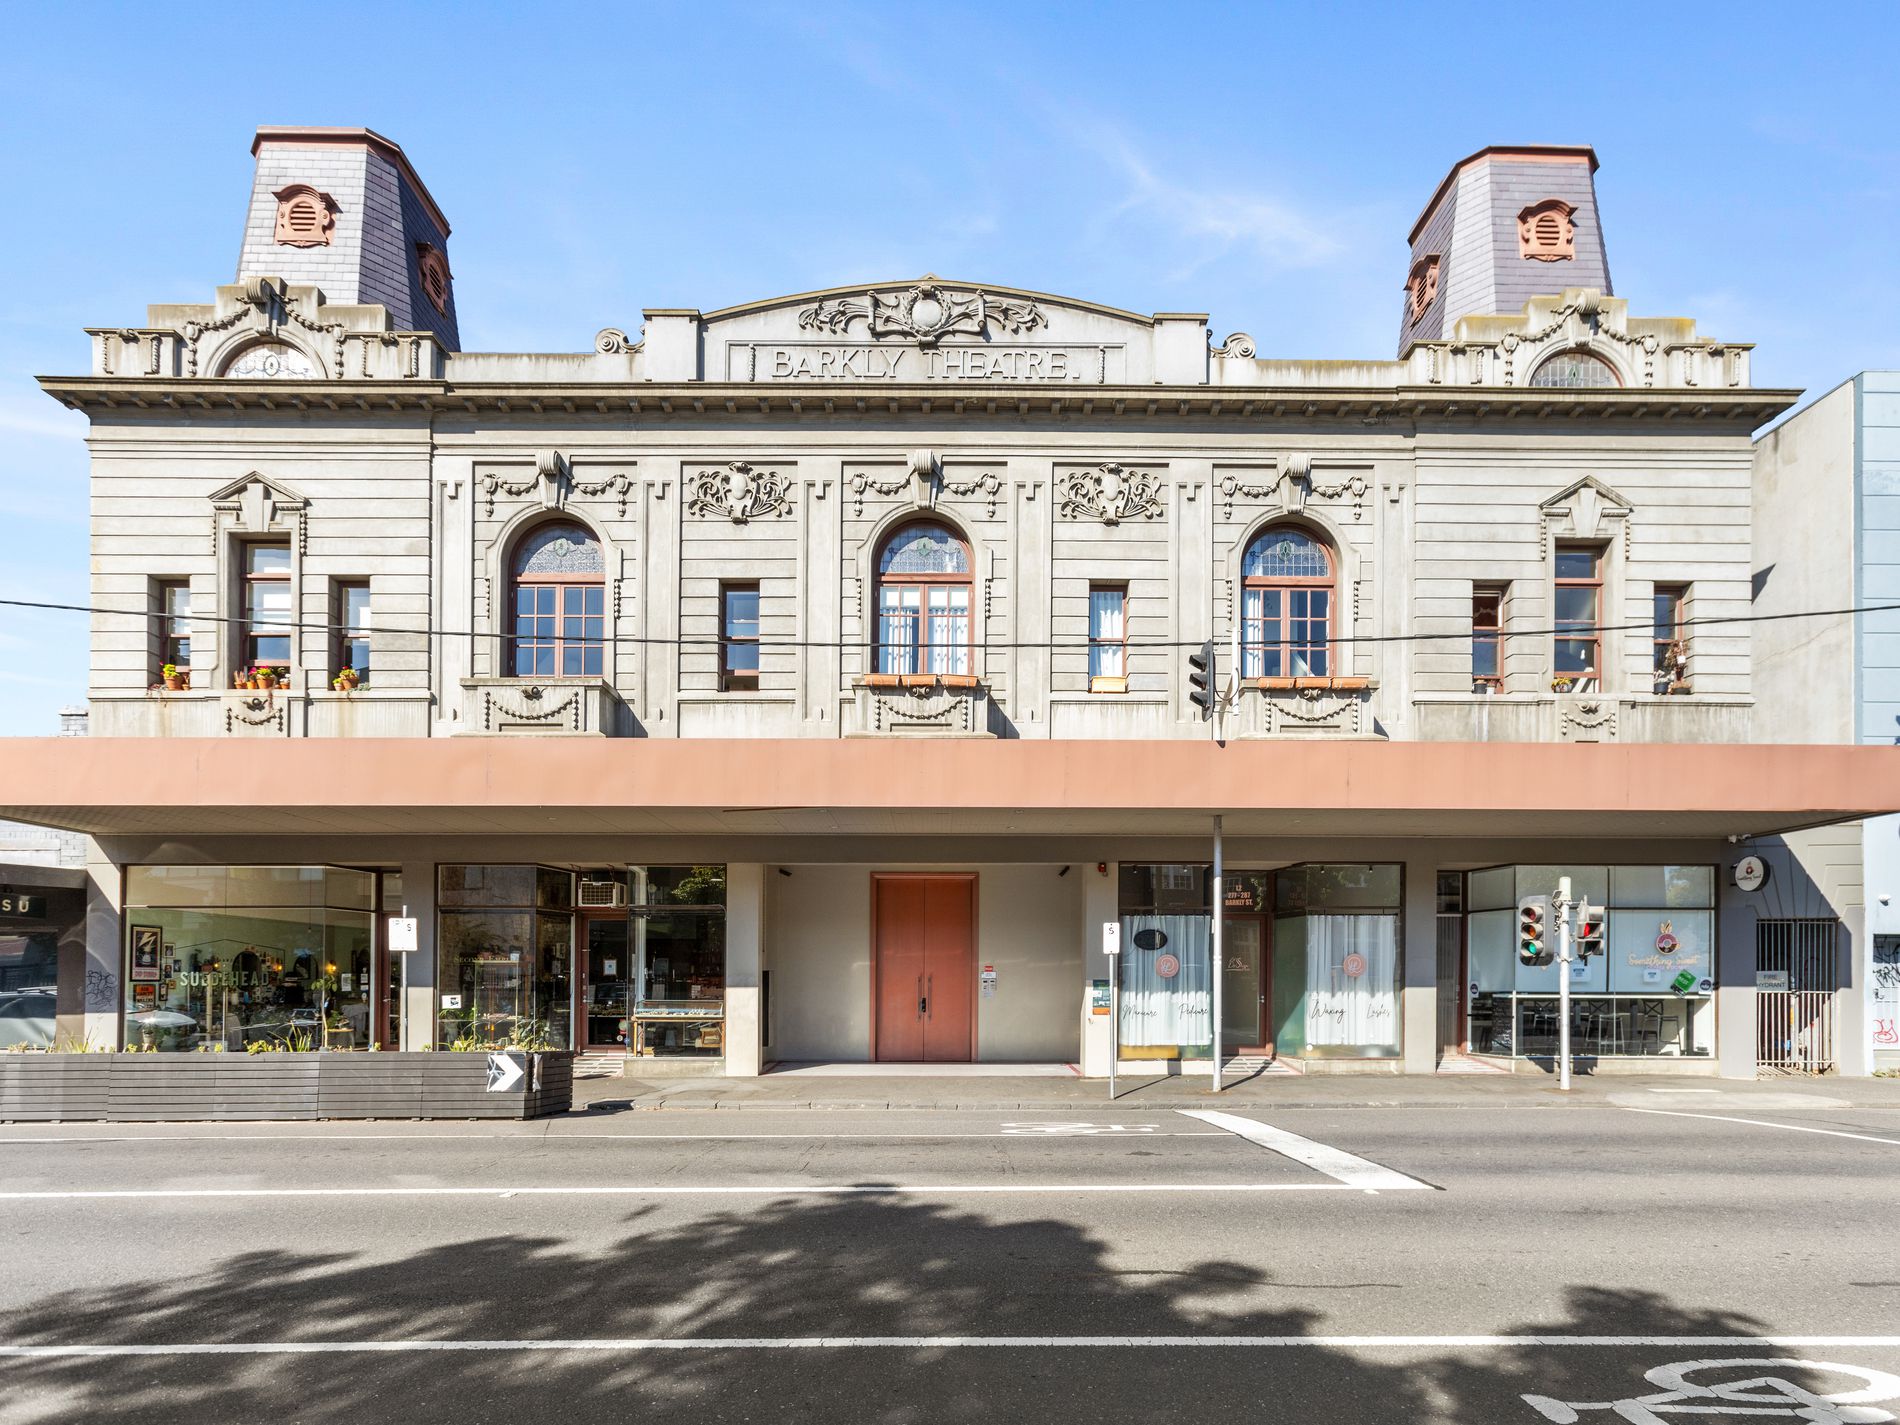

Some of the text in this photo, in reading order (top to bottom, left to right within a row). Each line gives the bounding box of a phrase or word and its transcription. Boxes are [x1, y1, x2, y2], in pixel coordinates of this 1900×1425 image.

[771, 349, 906, 379] BARKLY
[180, 971, 270, 987] SUEDEHEAD
[1123, 1004, 1158, 1021] Manicure
[1179, 1003, 1209, 1020] Pedicure
[1311, 1001, 1347, 1025] Waxing
